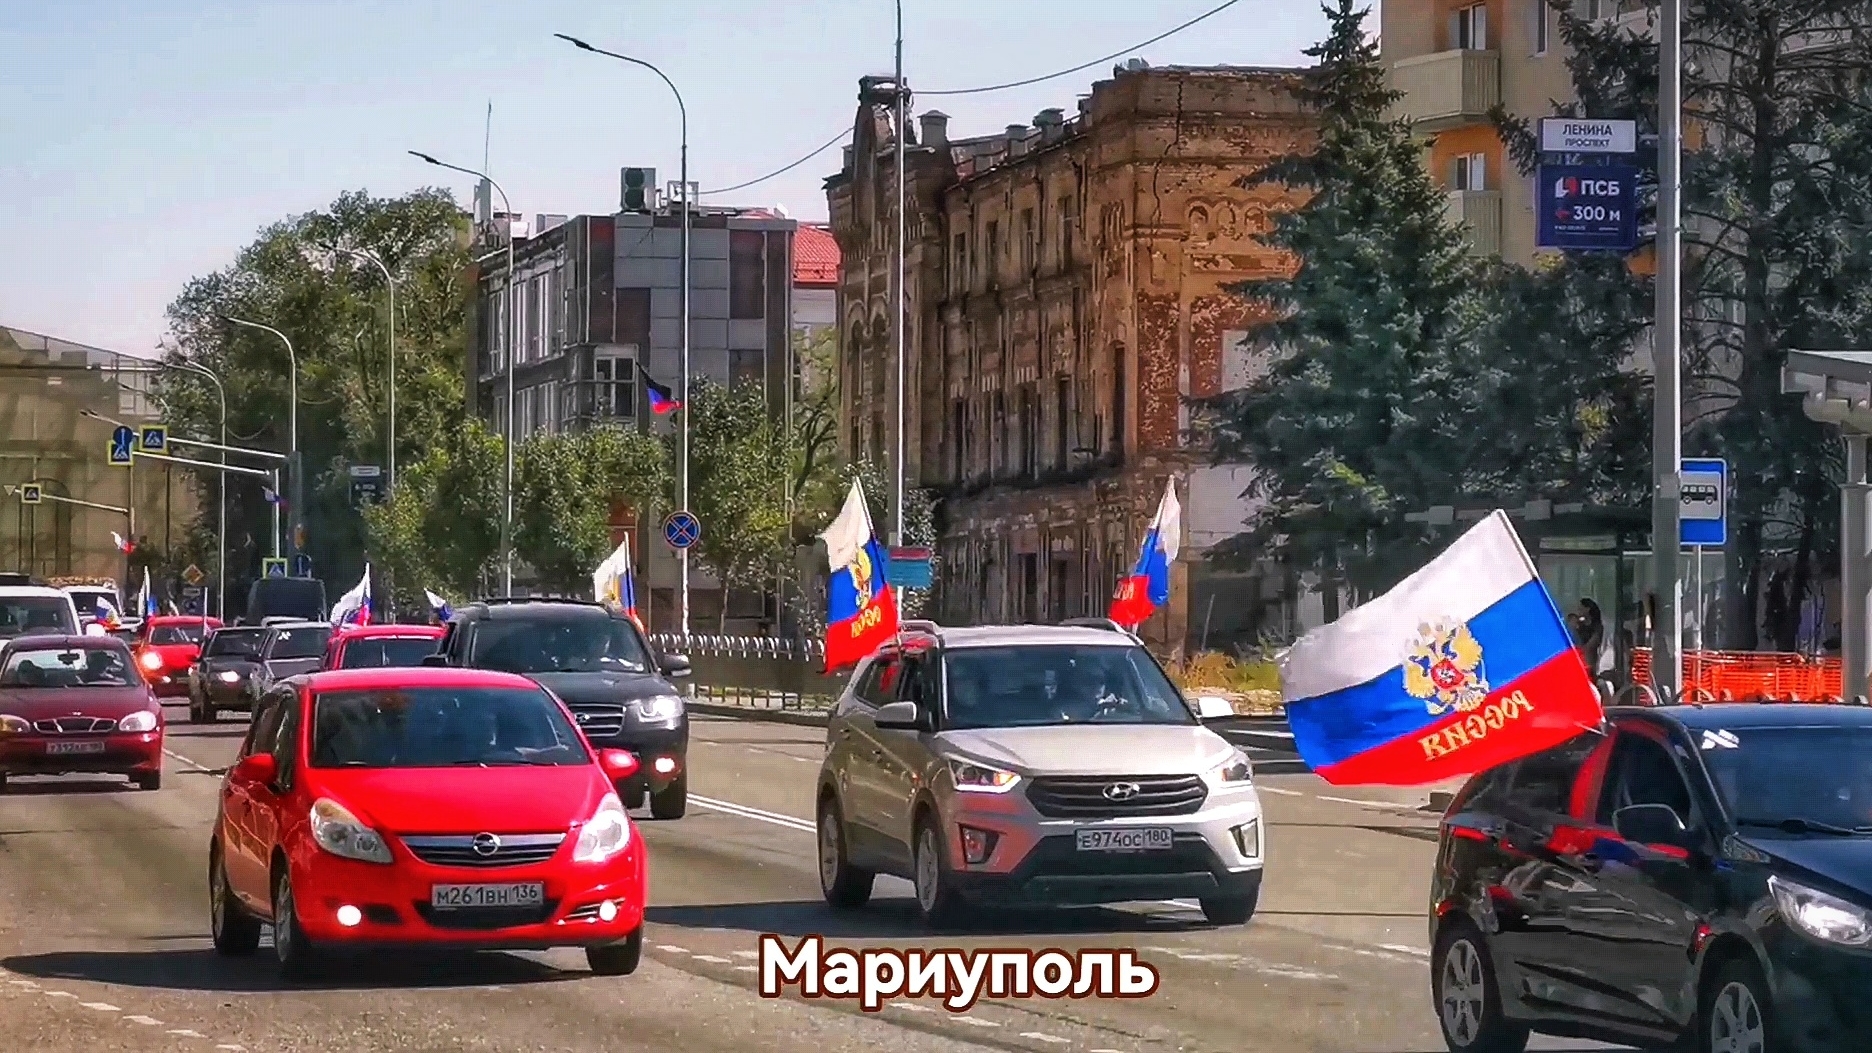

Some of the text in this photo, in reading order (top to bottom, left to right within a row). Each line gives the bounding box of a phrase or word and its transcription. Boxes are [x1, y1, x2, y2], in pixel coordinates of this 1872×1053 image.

[1562, 123, 1613, 136] ЛЕНИНА
[1581, 180, 1620, 196] ПСБ
[1573, 206, 1605, 221] 300
